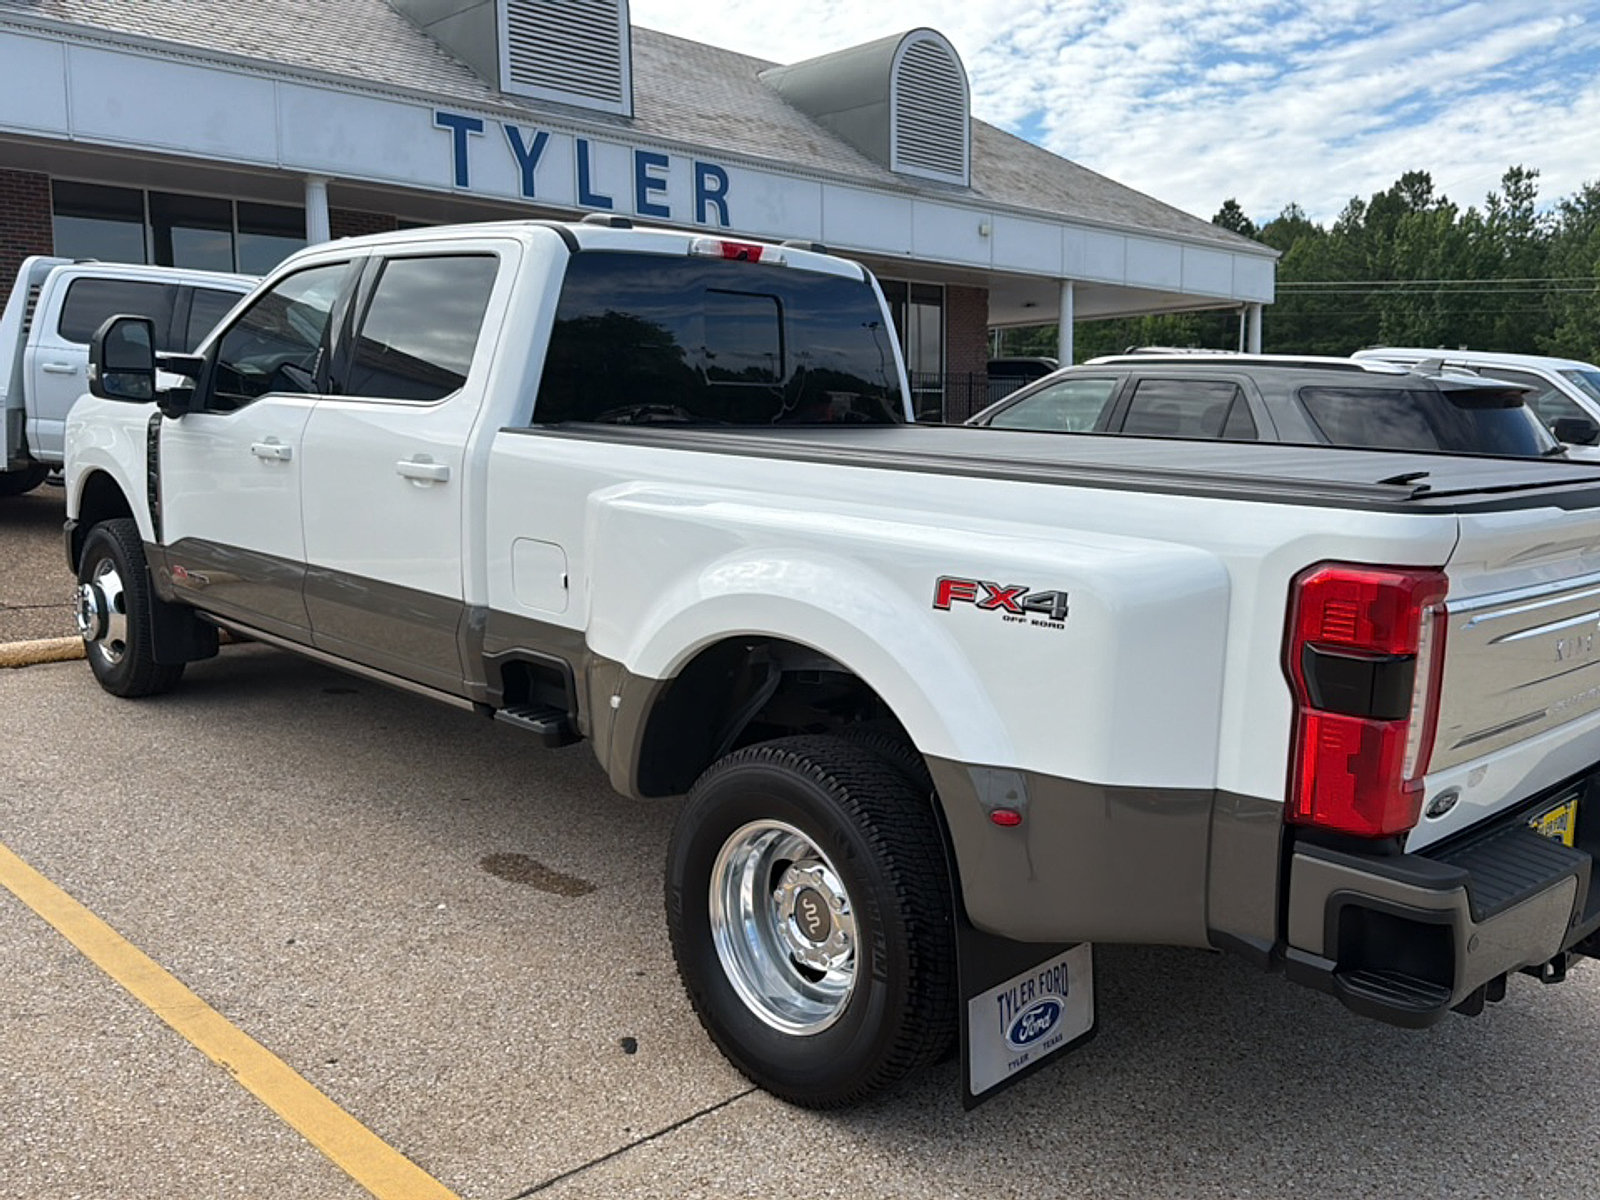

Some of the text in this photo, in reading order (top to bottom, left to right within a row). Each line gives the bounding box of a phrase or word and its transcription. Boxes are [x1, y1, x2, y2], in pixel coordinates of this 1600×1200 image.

[434, 110, 731, 228] TYLER
[932, 574, 1069, 622] FX4
[1002, 615, 1065, 630] OFF ROAD
[997, 961, 1068, 1035] TYLER FORD
[1018, 1006, 1053, 1041] Ford
[1008, 1053, 1029, 1071] TYLER
